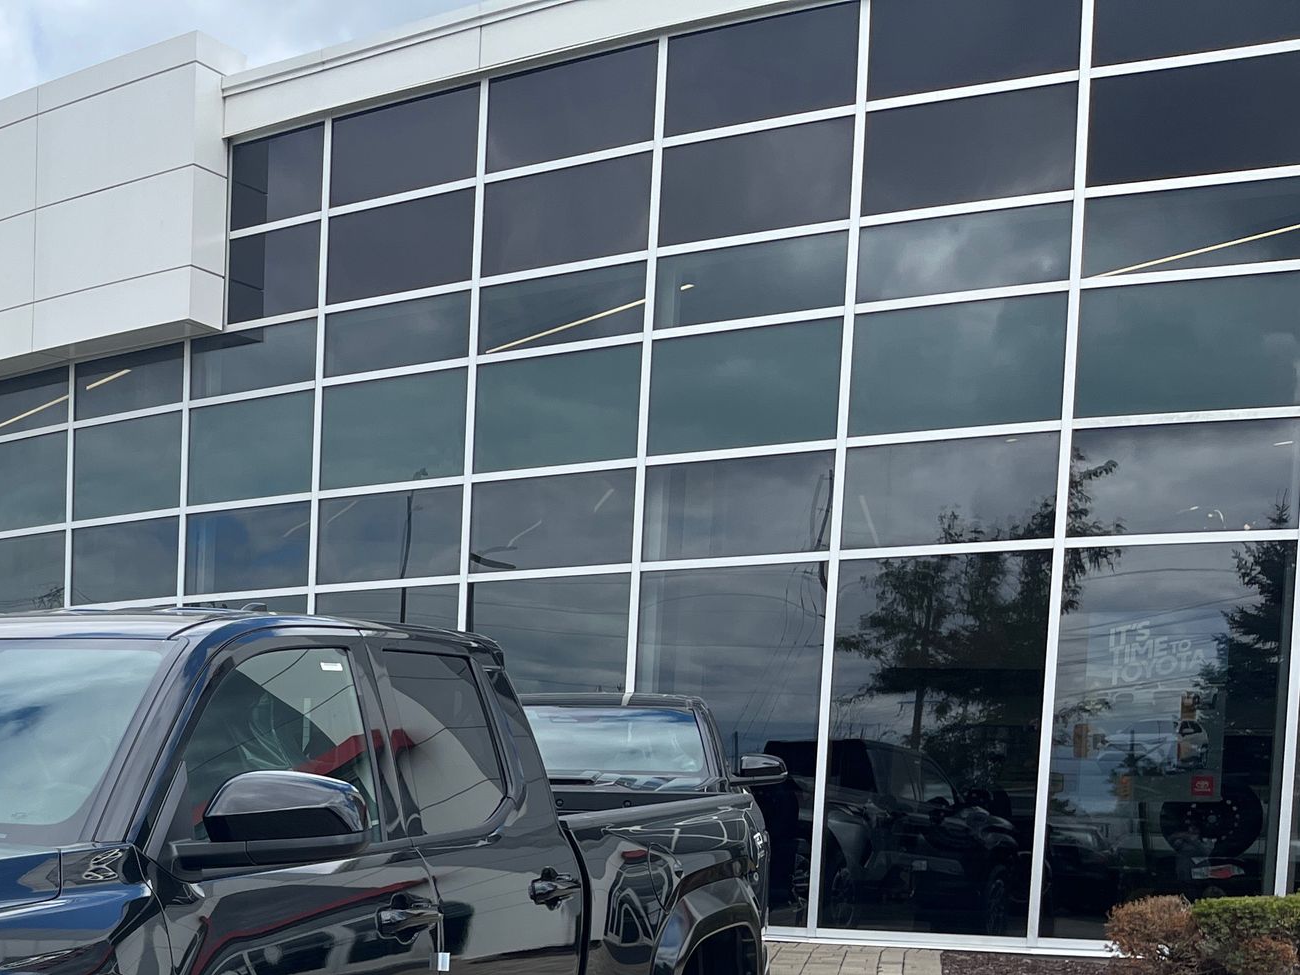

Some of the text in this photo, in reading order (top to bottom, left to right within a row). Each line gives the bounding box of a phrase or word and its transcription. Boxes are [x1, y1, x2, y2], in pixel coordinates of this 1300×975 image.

[1109, 621, 1150, 647] IT'S
[1109, 636, 1191, 664] TIME TO
[1108, 649, 1205, 685] TOYOTA
